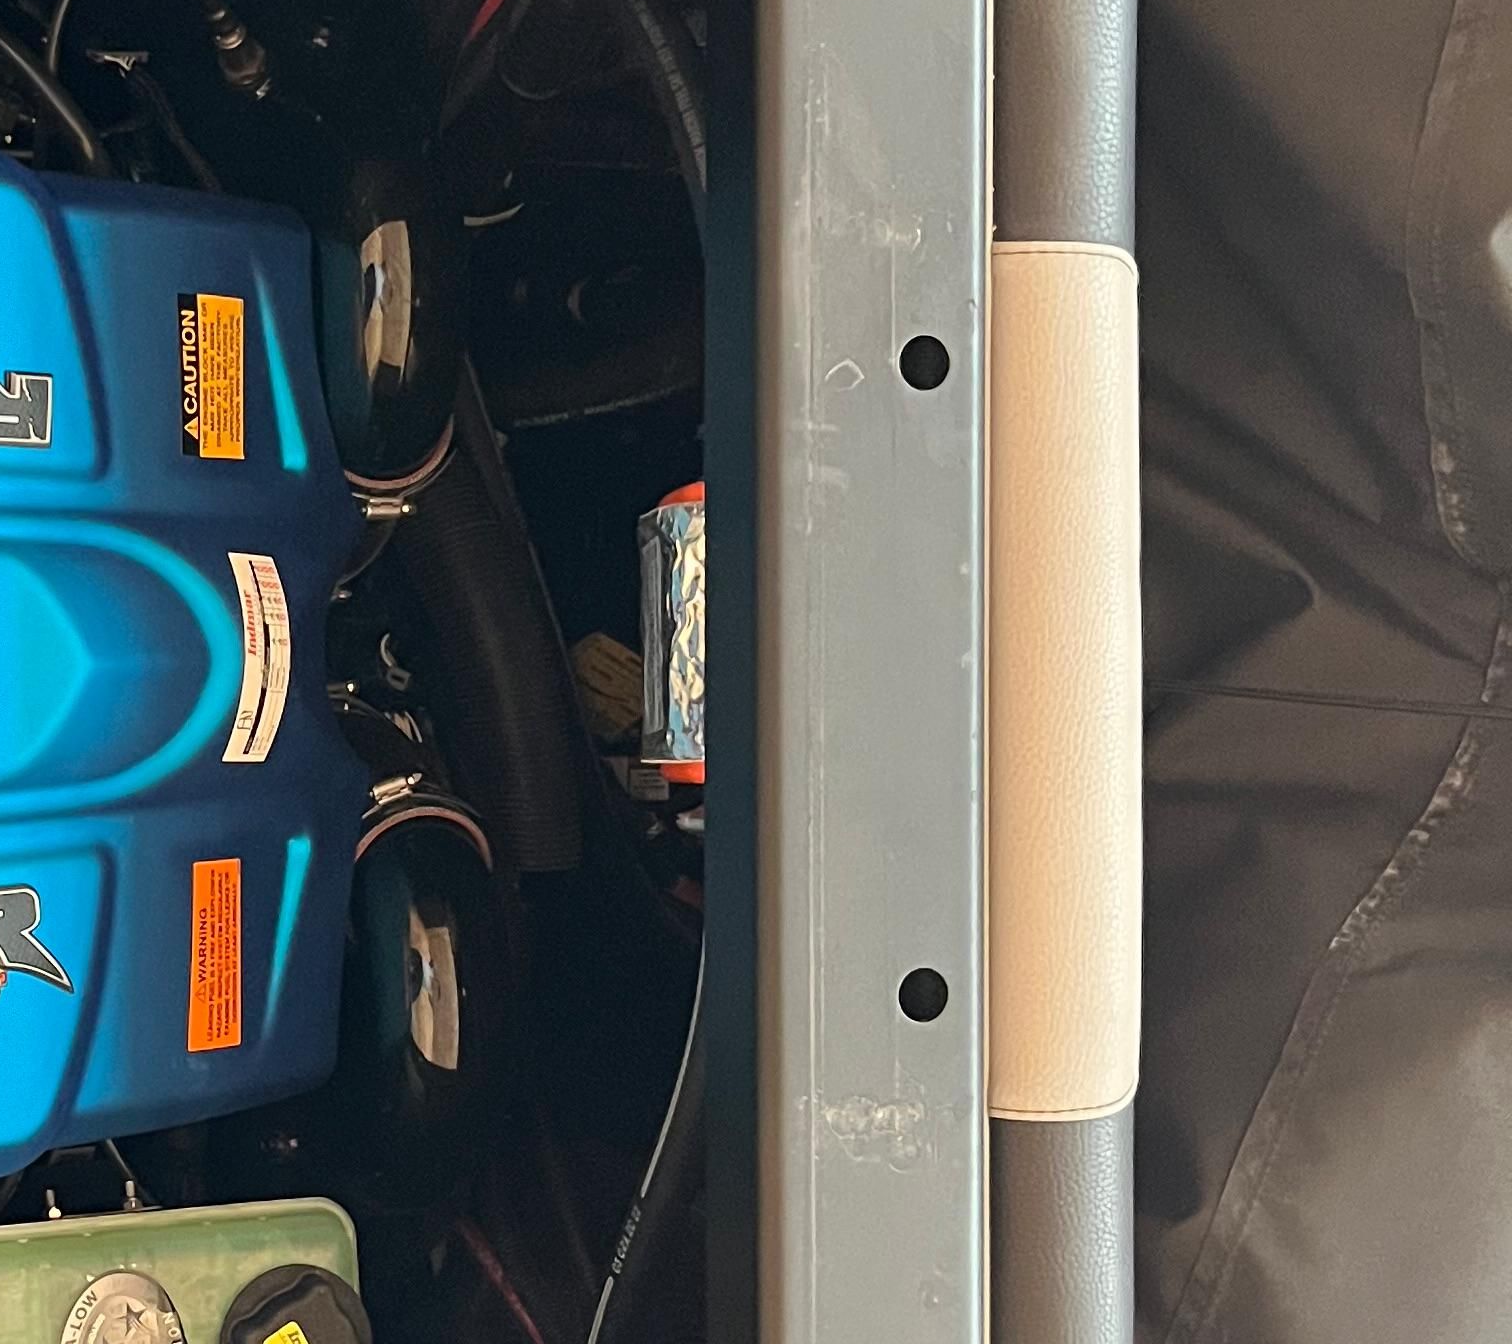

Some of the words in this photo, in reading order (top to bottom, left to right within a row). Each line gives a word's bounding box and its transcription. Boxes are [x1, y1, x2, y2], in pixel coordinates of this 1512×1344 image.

[181, 310, 198, 414] CAUTION
[243, 589, 257, 656] Indmar
[199, 908, 207, 983] WARNING
